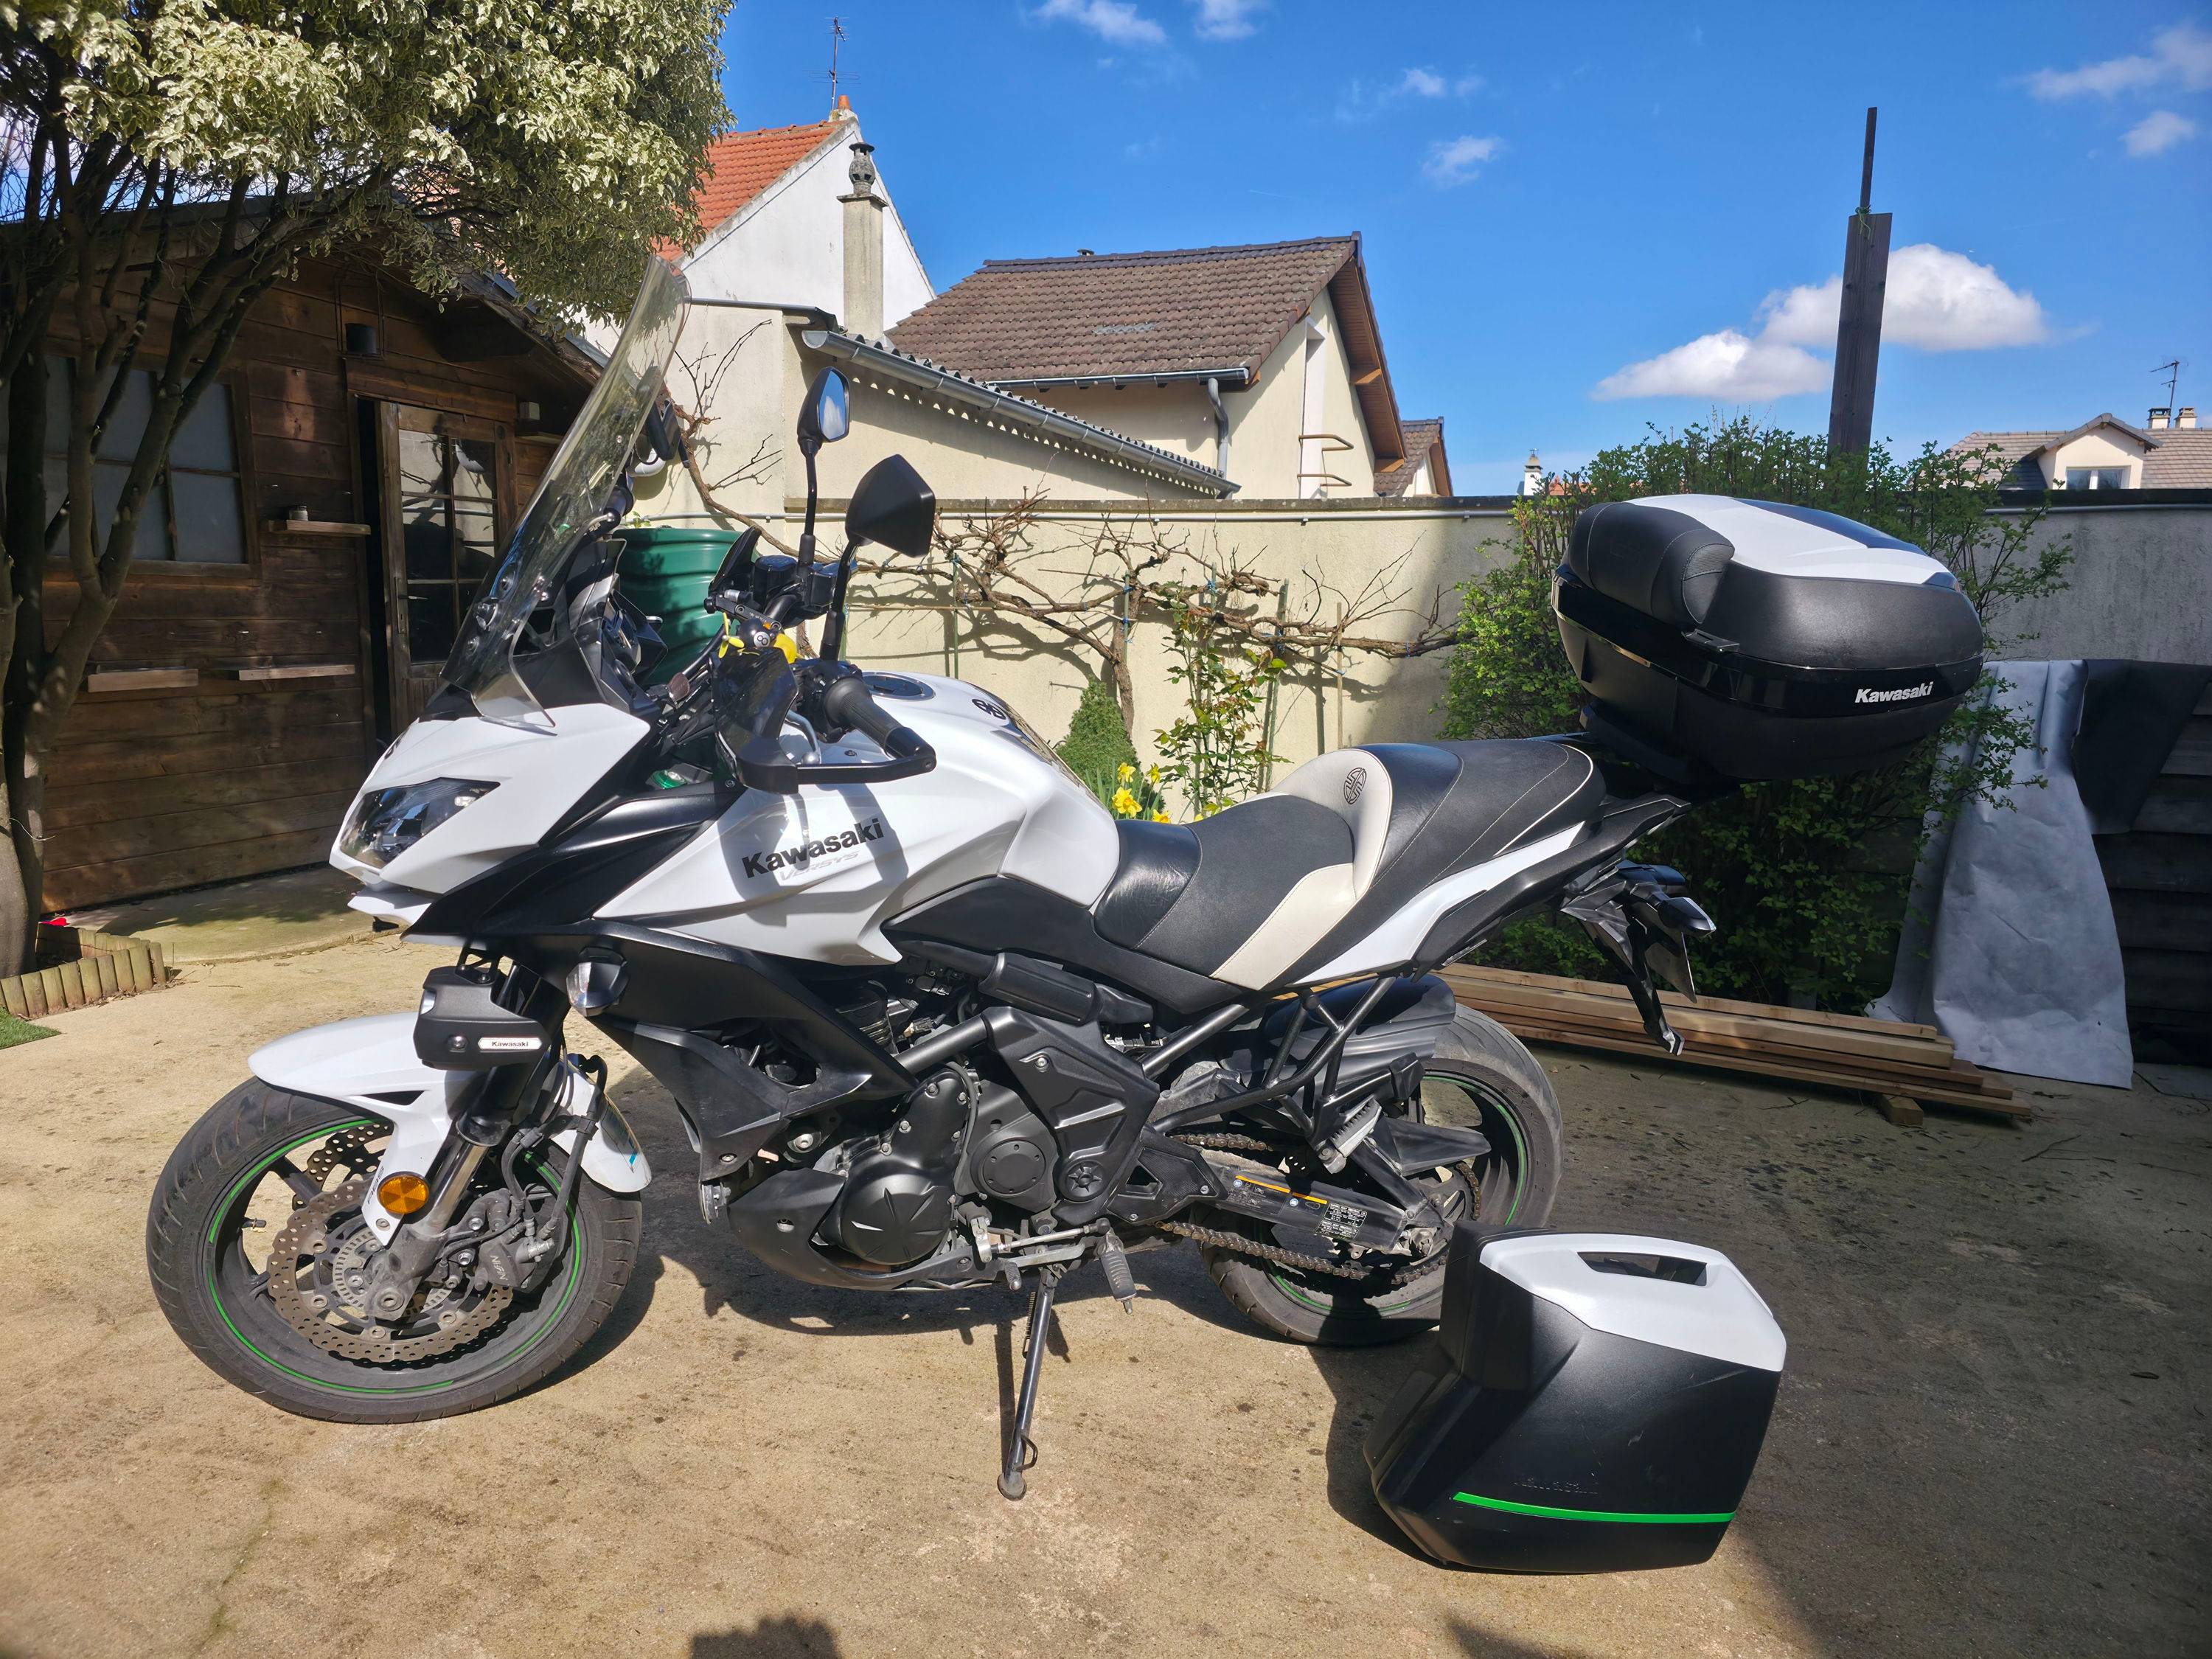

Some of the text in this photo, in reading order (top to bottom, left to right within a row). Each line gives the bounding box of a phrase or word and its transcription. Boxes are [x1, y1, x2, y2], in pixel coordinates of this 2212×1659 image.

[757, 635, 768, 646] 8
[1854, 681, 1934, 703] Kawasaki
[742, 818, 884, 878] Kawasaki
[780, 850, 860, 881] VERSYS
